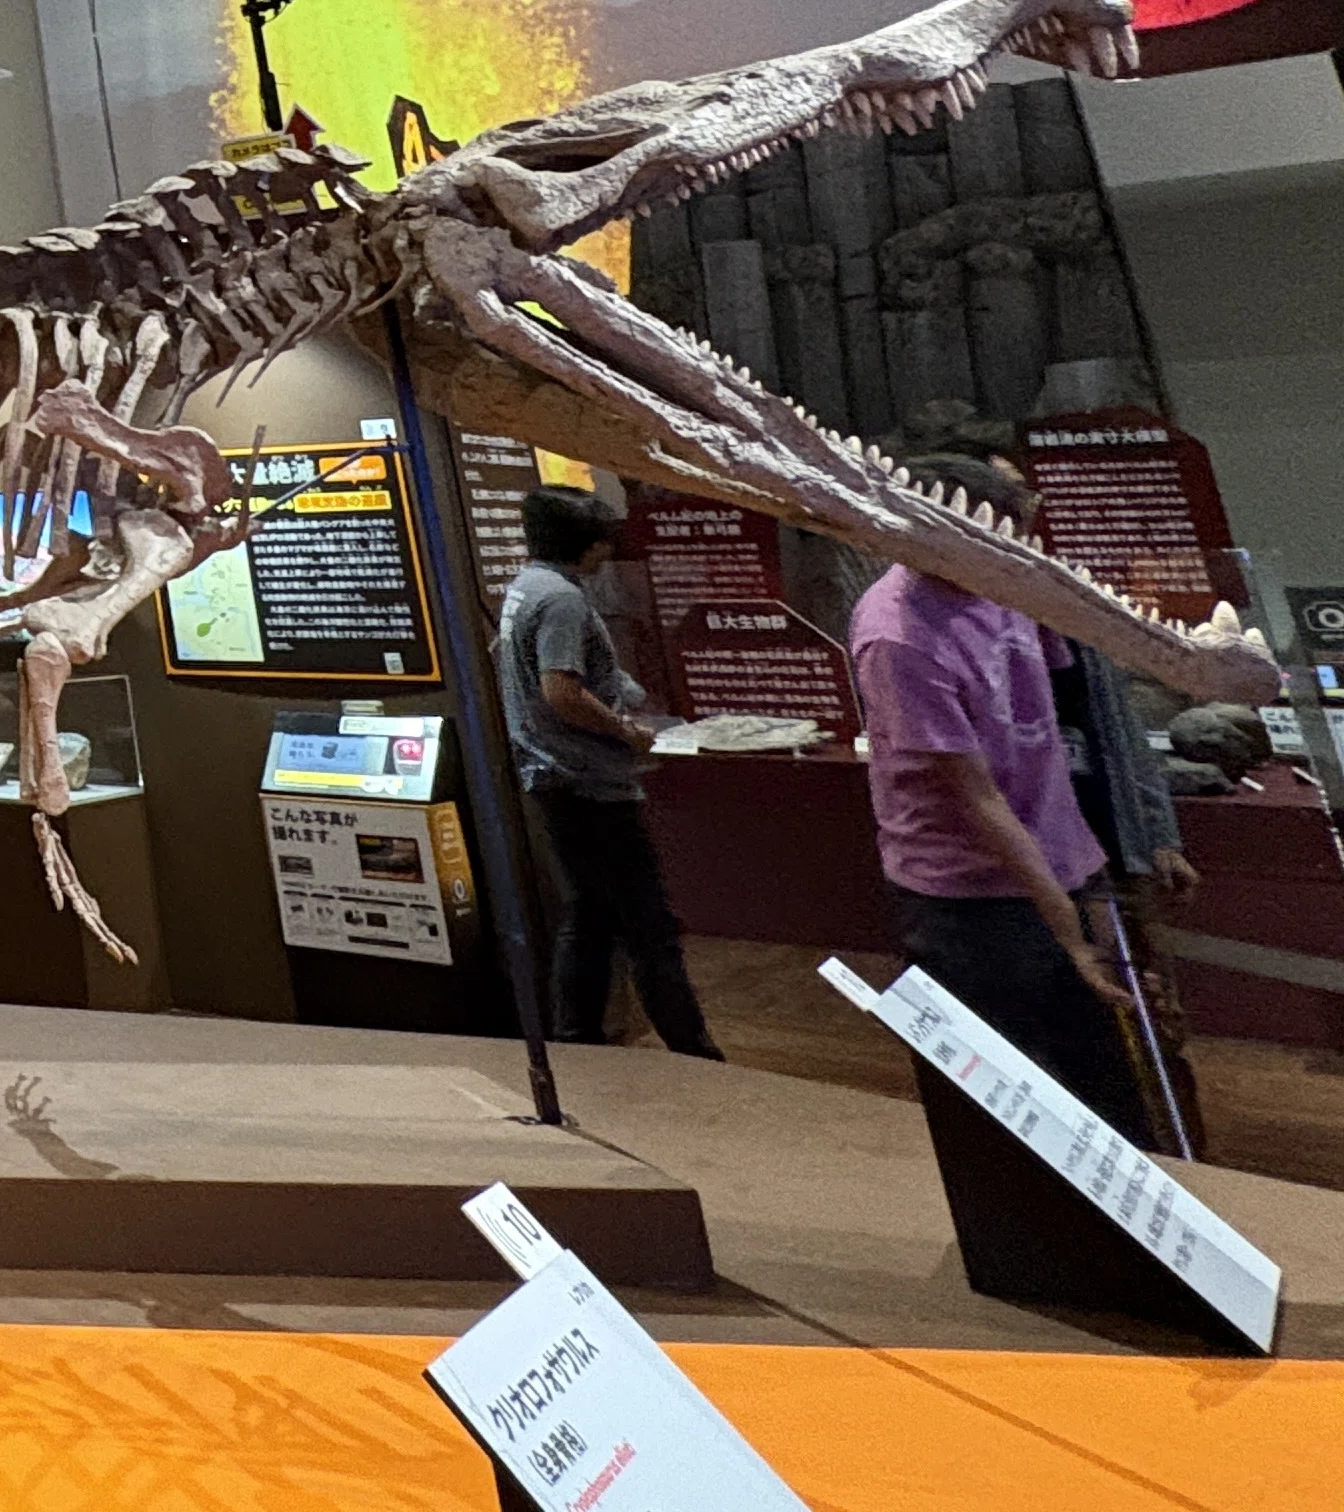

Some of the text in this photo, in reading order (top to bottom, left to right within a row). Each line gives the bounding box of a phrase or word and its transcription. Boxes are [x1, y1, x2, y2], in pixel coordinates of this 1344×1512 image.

[270, 807, 359, 828] こんな写真が
[500, 1203, 542, 1246] 10
[486, 1327, 601, 1444] クリオロフォサウルス
